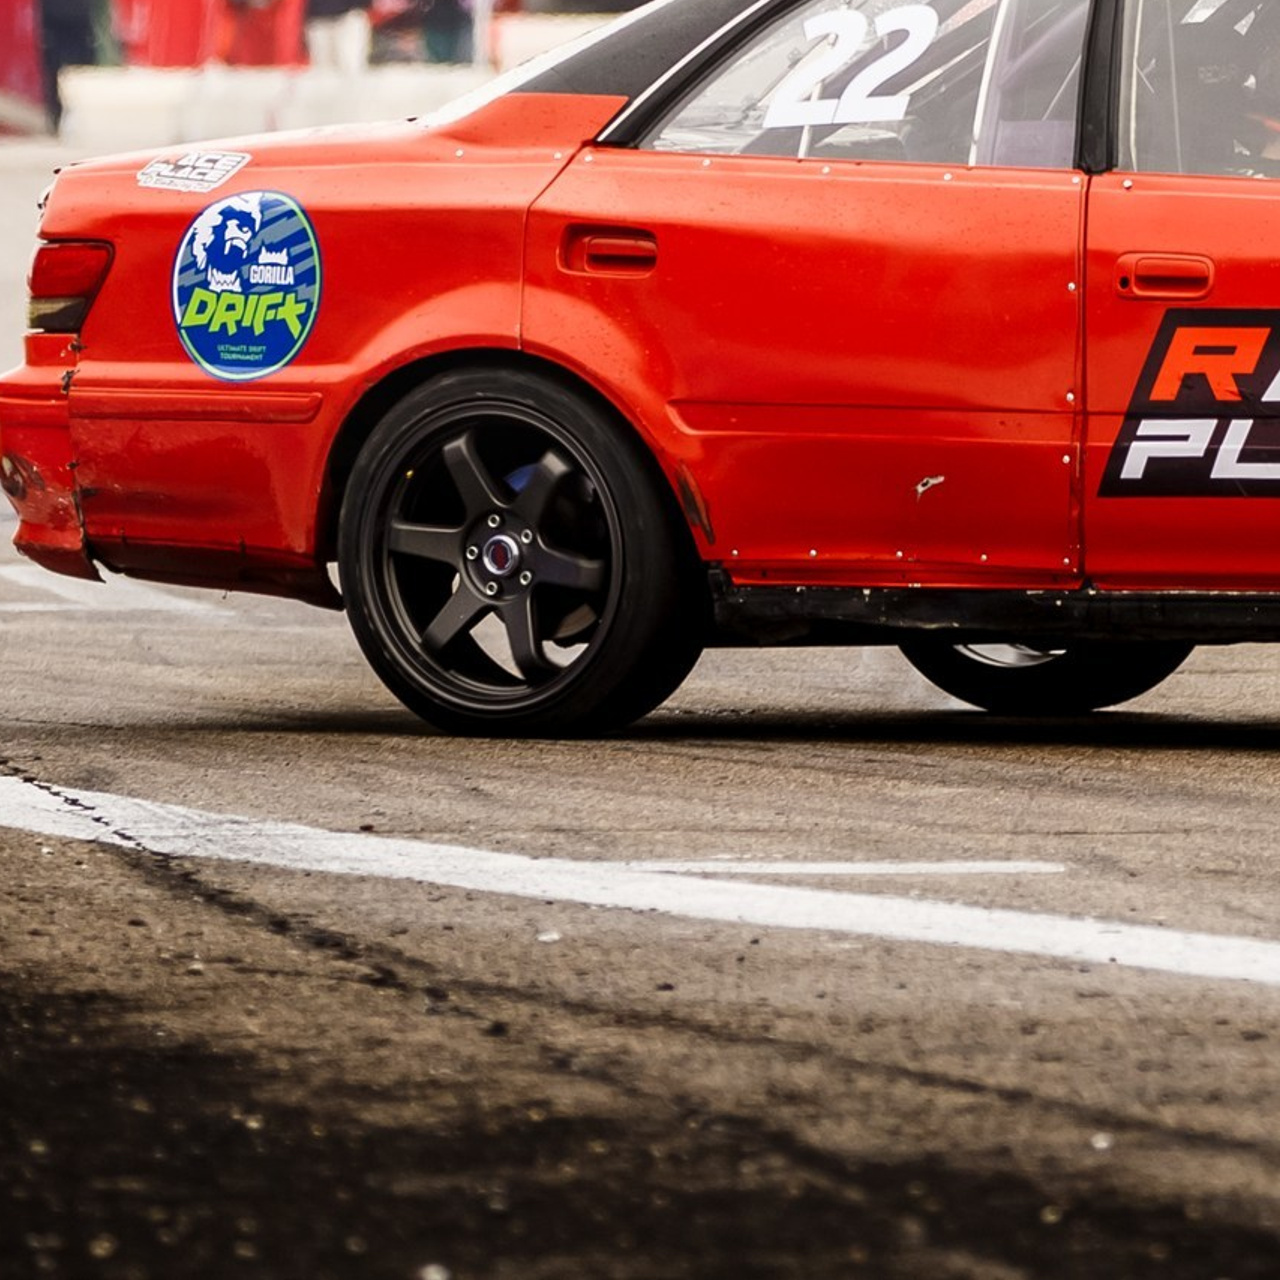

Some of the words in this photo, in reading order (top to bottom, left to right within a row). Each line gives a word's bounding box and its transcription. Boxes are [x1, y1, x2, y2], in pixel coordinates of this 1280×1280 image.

[763, 4, 939, 128] 22
[164, 152, 245, 171] ACE
[250, 265, 295, 286] GORILLA
[180, 287, 307, 340] DRIFT
[217, 344, 247, 353] ULTIMATE
[248, 345, 267, 353] DRIFT
[220, 352, 263, 361] TOURNAMENT
